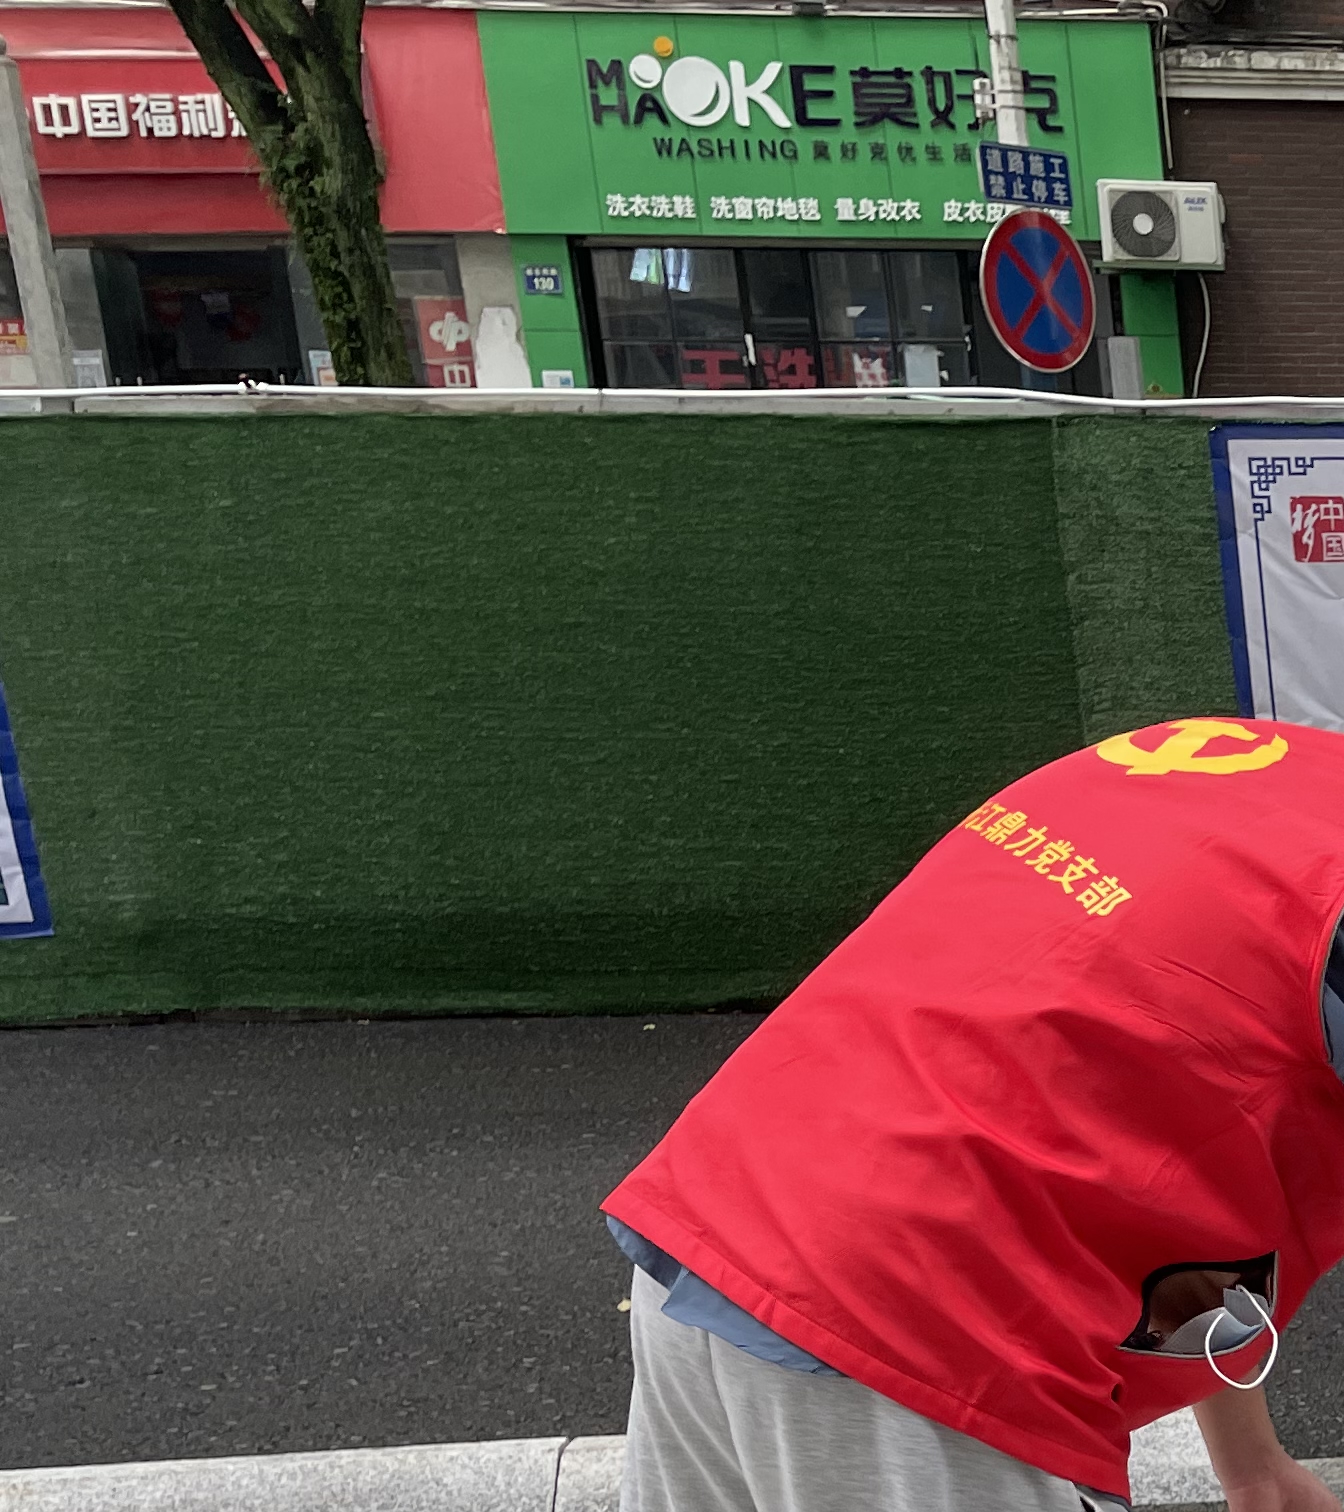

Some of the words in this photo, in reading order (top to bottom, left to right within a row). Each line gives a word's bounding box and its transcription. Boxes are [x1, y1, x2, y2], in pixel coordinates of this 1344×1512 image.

[653, 136, 799, 162] WASHING
[985, 147, 1067, 178] 道路施工
[988, 173, 1070, 205] 禁止停车
[605, 193, 697, 219] 洗衣洗鞋
[834, 197, 922, 222] 量身改衣
